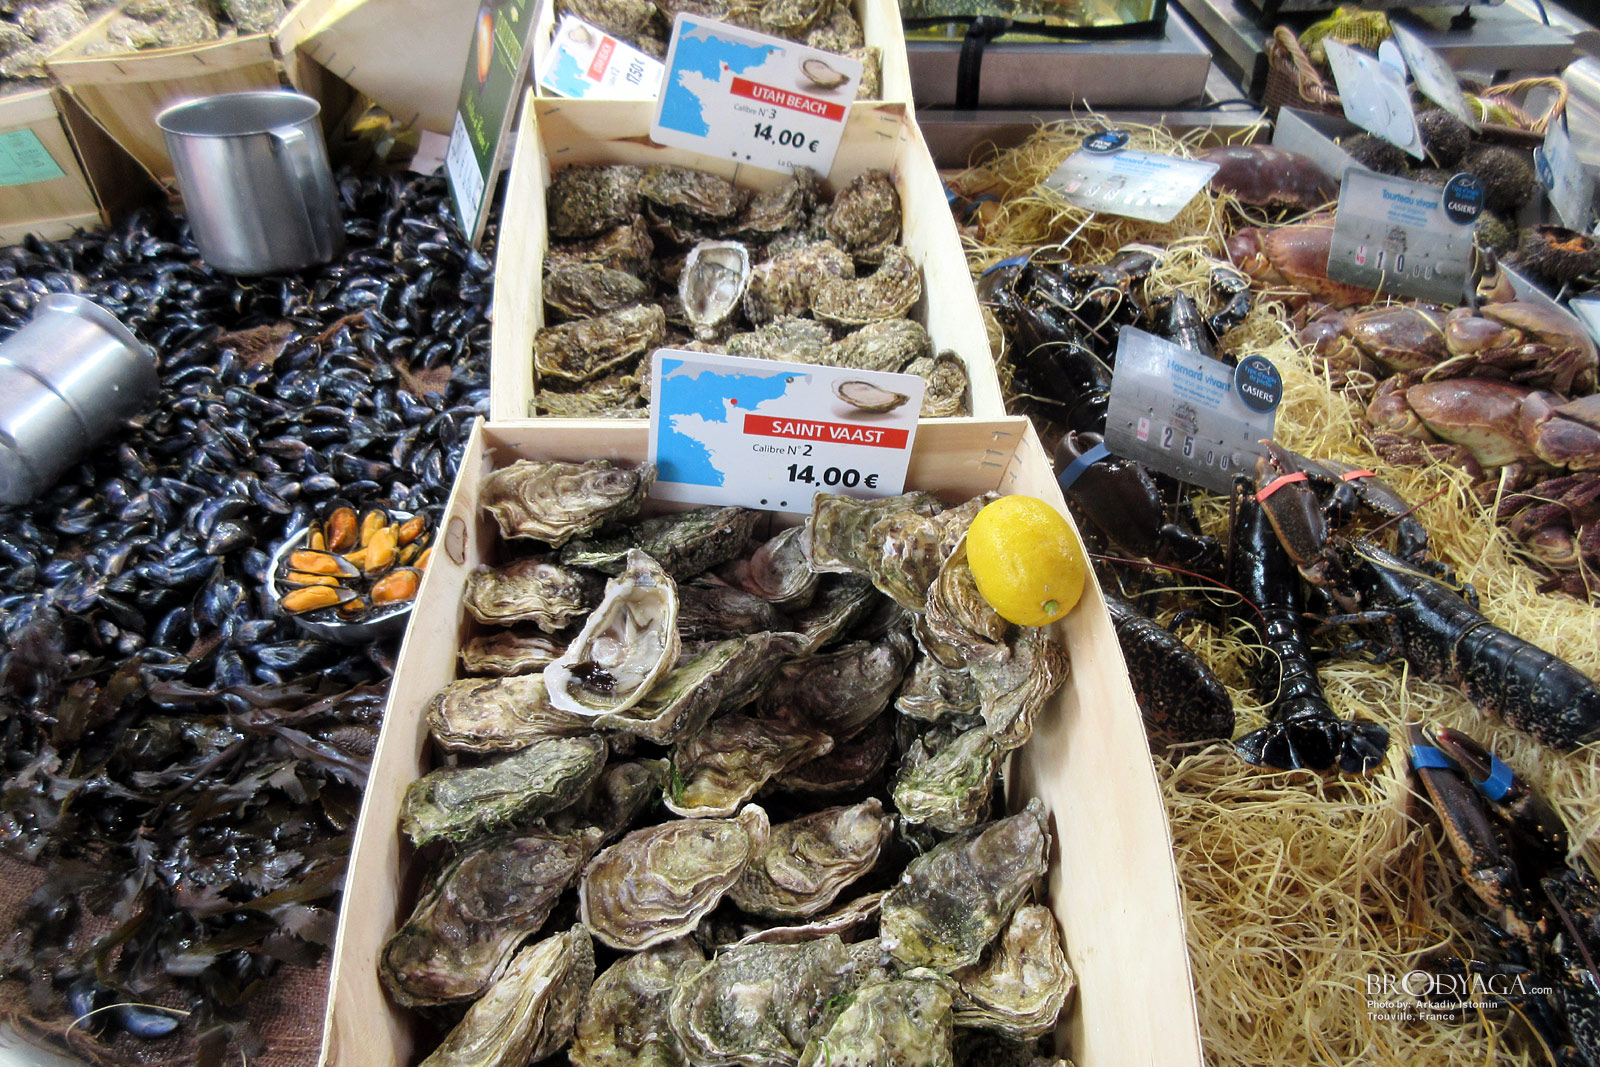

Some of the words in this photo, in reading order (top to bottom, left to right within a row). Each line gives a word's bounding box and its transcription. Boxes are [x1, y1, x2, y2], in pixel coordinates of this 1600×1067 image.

[733, 102, 757, 116] Calibre
[768, 108, 777, 120] 3
[752, 85, 786, 105] UTAH
[786, 92, 828, 115] BEACH
[753, 122, 805, 148] 14,00
[808, 139, 820, 153] €
[1382, 188, 1415, 205] Tourteau
[1415, 196, 1439, 210] vivant
[1447, 201, 1477, 215] CASIERS
[1167, 359, 1203, 381] Homard
[1205, 373, 1232, 392] vivant
[1241, 382, 1274, 403] CASIERS
[771, 419, 825, 438] SAINT
[829, 425, 885, 444] VAAST
[752, 443, 785, 455] Calibre
[802, 444, 813, 457] 2
[787, 463, 861, 488] 14,00
[864, 473, 879, 489] €
